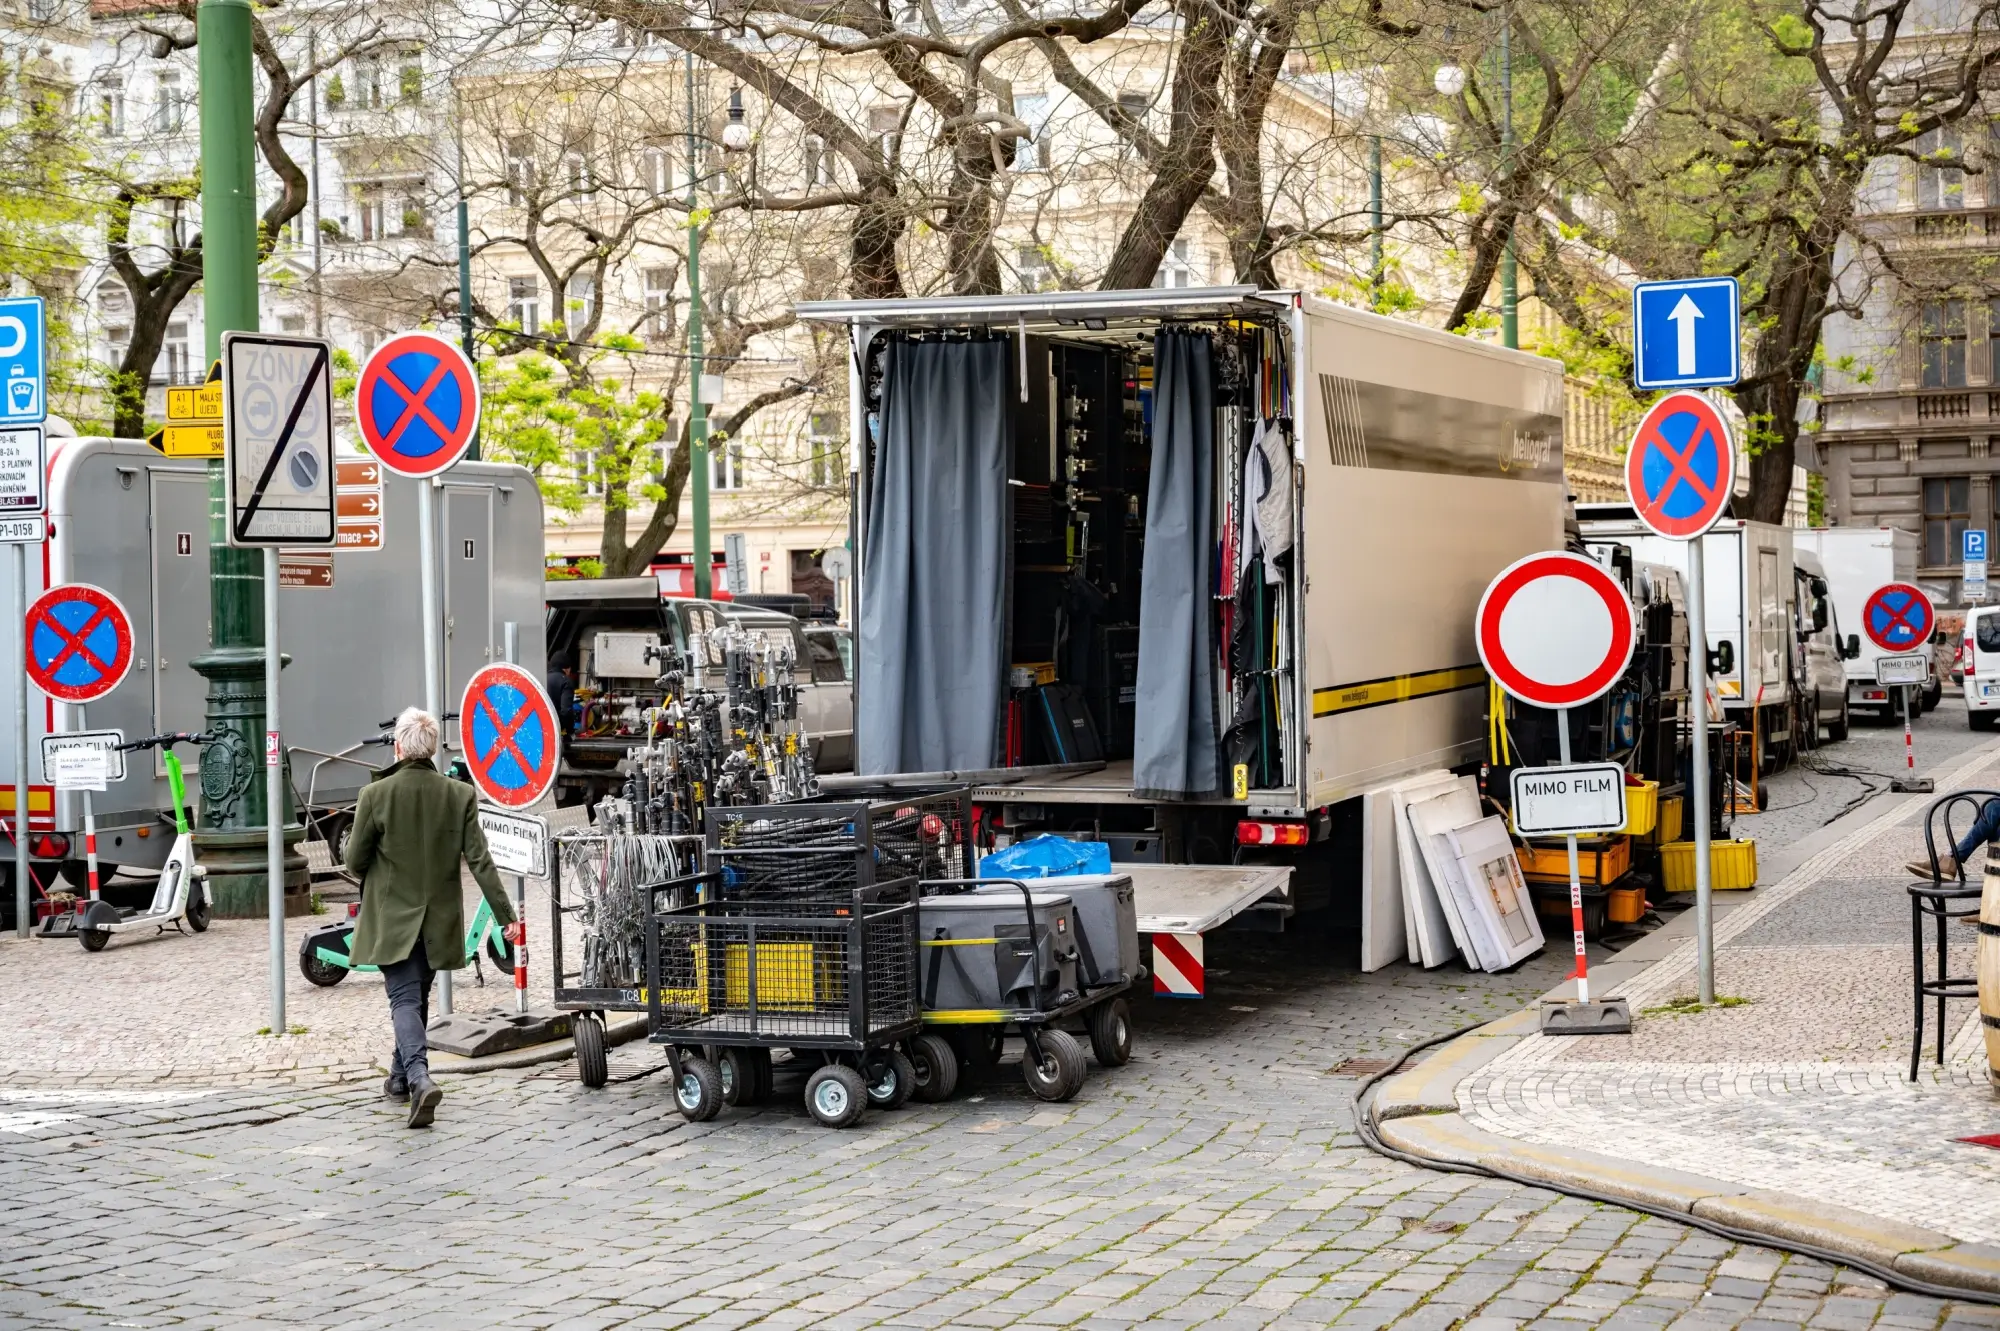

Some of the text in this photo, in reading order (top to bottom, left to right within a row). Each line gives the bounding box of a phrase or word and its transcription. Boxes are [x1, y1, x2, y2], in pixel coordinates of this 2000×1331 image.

[16, 448, 20, 456] h
[8, 458, 32, 468] PLATNÝM
[1968, 533, 1982, 552] P
[1881, 660, 1923, 669] MIMO FILM
[1525, 778, 1611, 796] MIMO FILM
